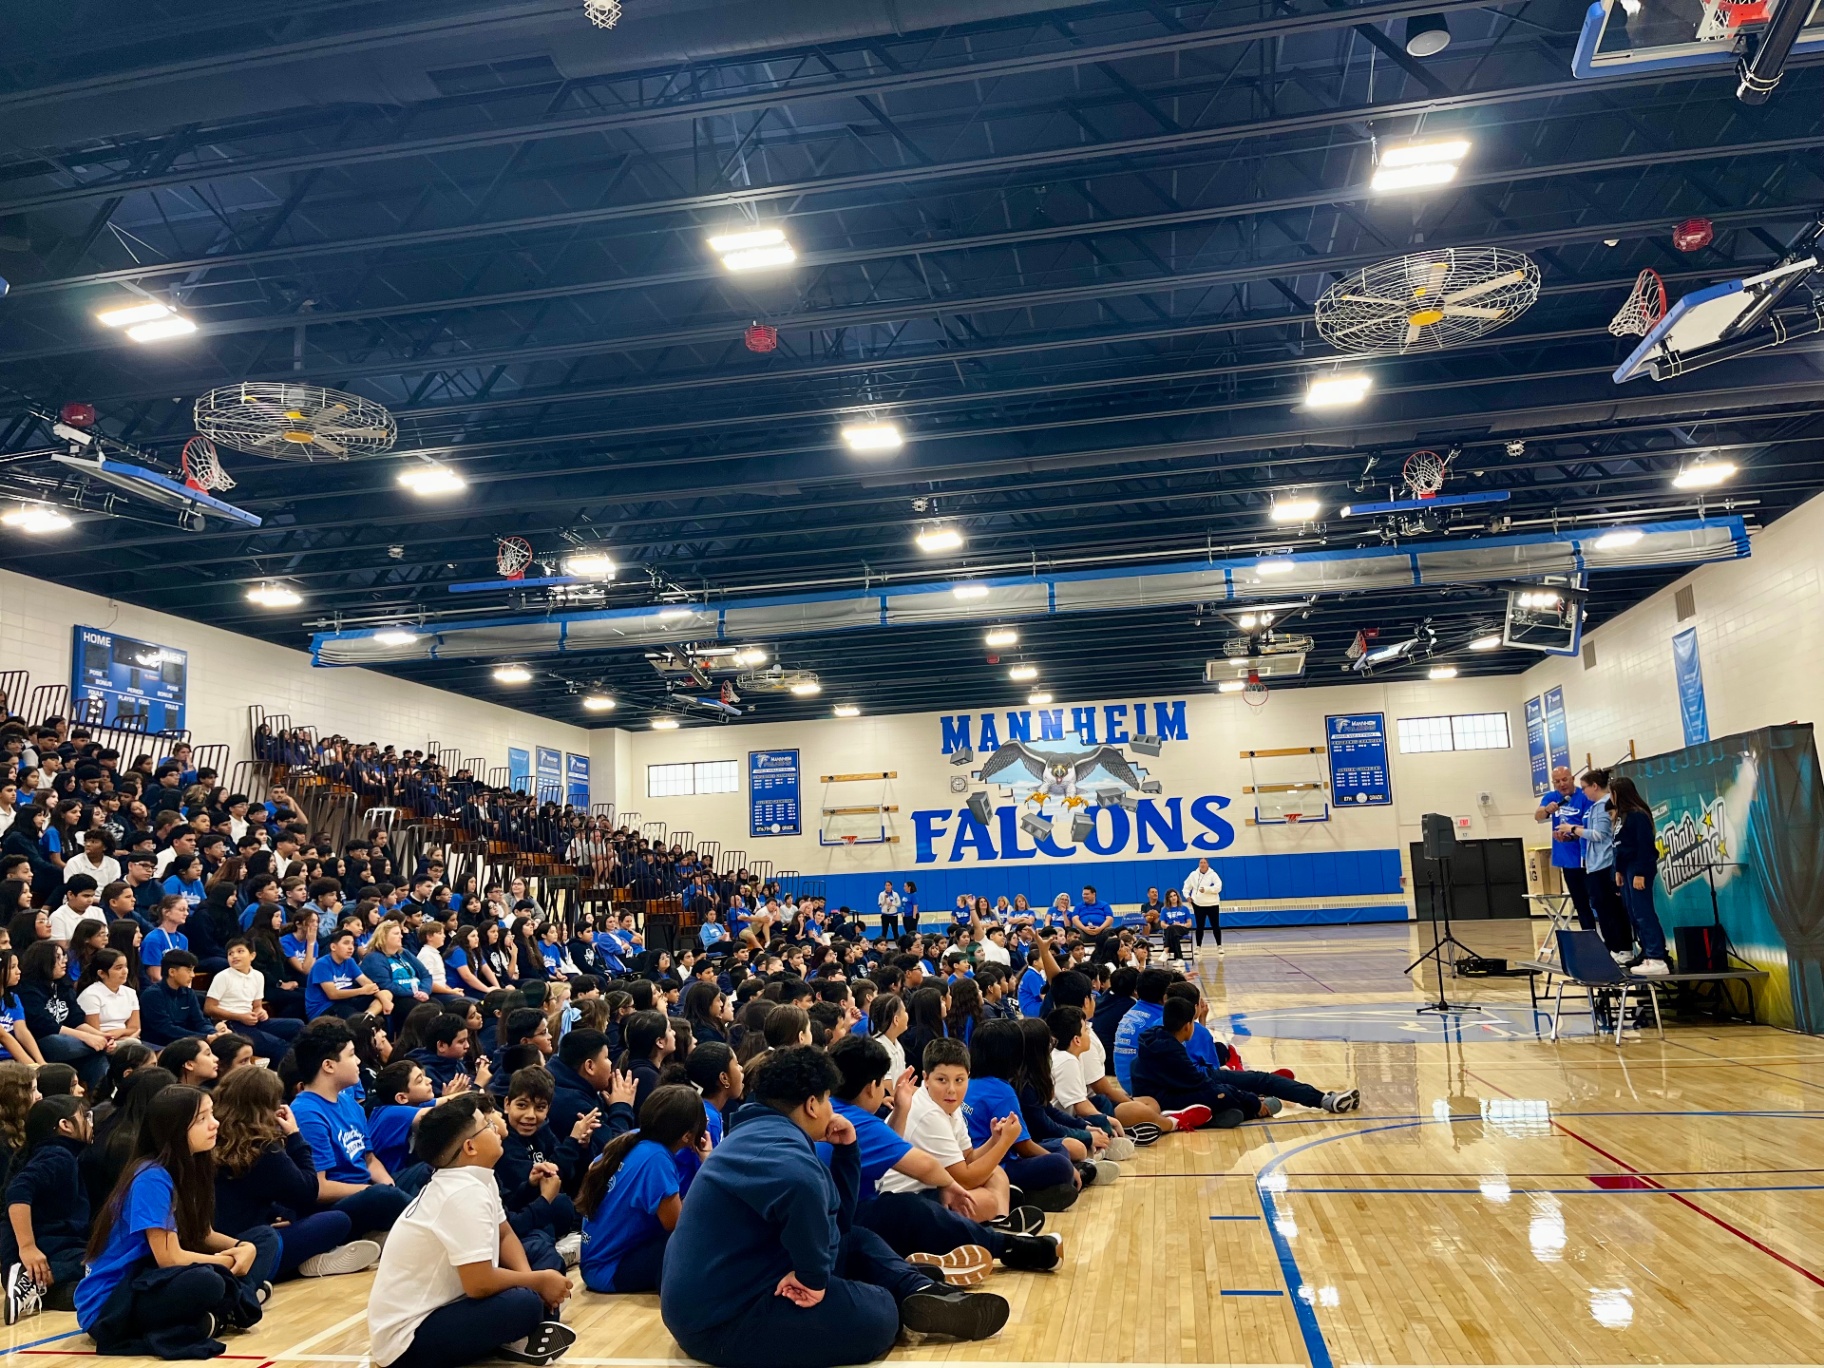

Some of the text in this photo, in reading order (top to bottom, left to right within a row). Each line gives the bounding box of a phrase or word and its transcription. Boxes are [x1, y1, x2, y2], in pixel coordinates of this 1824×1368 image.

[83, 631, 111, 647] HOME
[940, 701, 1188, 754] MANNHEIM
[910, 795, 1235, 864] FALCONS
[1662, 802, 1725, 895] Amazing!
[1665, 817, 1696, 857] That's
